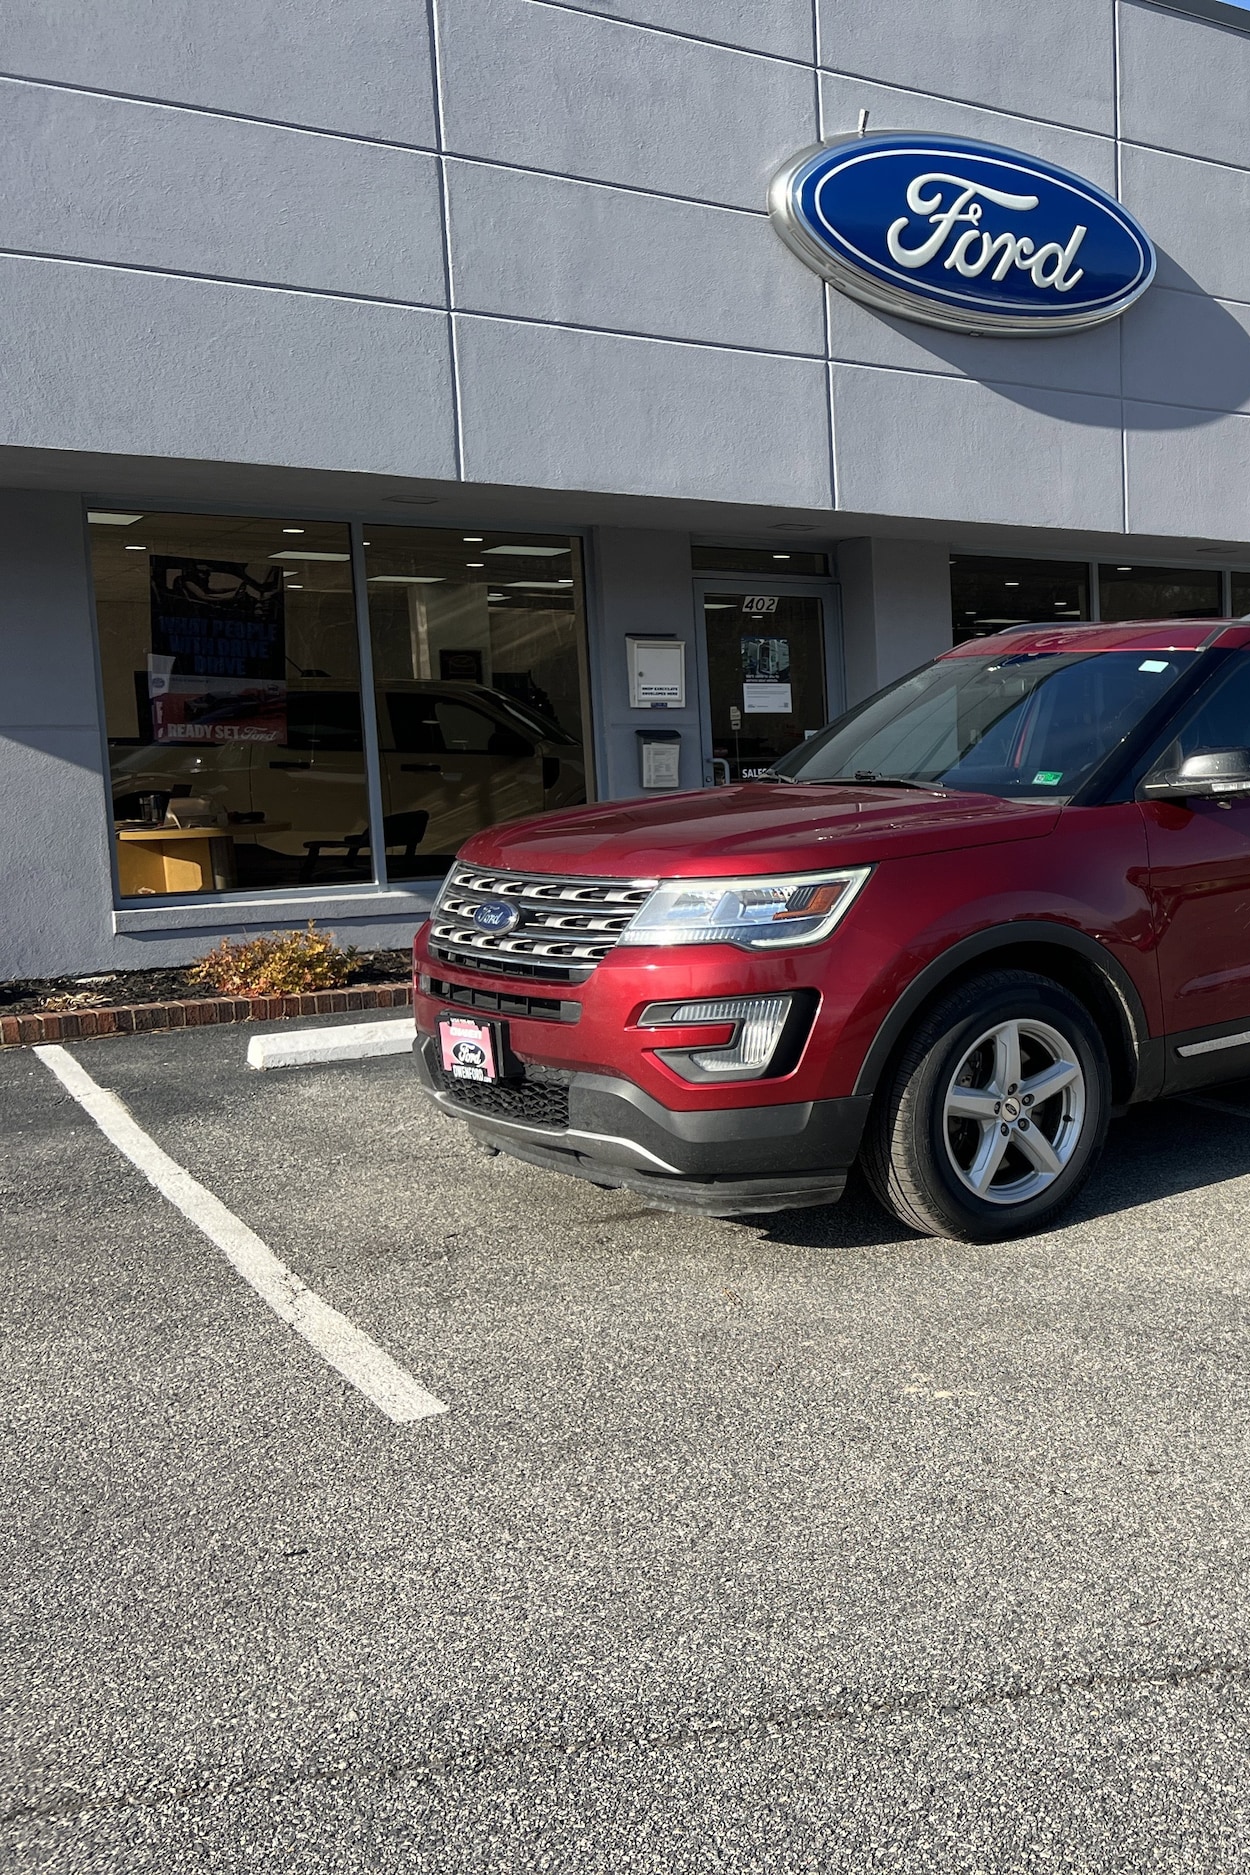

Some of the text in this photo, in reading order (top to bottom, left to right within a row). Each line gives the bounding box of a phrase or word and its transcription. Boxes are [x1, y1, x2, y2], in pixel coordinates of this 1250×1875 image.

[887, 172, 1087, 292] Ford
[744, 597, 776, 611] 402
[212, 619, 278, 641] PEOPLE
[217, 638, 271, 658] DRIVE
[194, 655, 247, 675] DRIVE
[167, 723, 279, 741] READY SET Ford
[478, 906, 502, 925] Ford
[458, 1043, 481, 1064] Ford
